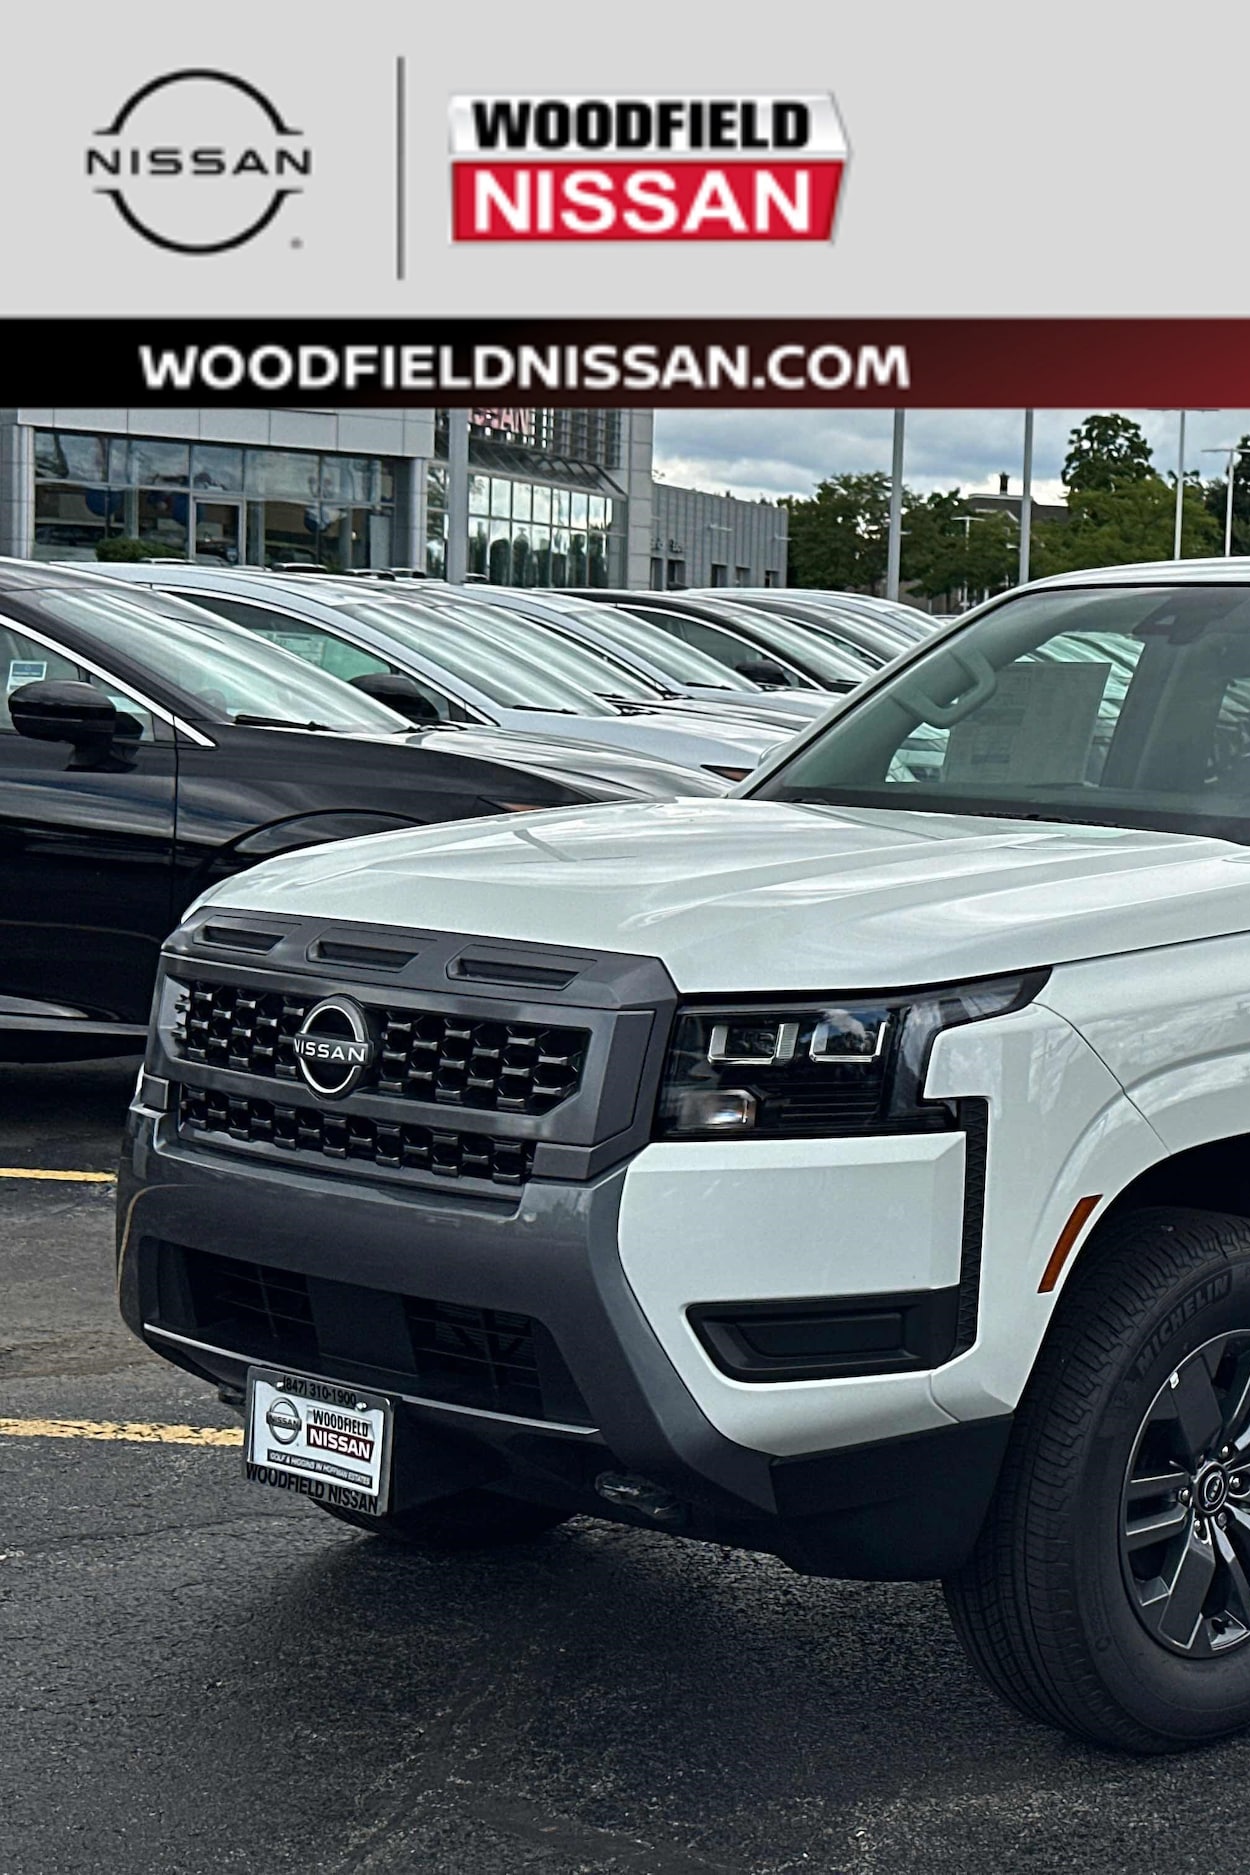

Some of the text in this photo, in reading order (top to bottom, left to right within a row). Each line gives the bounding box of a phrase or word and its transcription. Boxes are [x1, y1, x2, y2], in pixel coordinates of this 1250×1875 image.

[294, 1037, 365, 1062] NISSAN
[1137, 1274, 1229, 1375] MICHELIN
[283, 1376, 357, 1407] (847) 310-1900
[313, 1408, 369, 1438] WOODFIELD
[309, 1428, 370, 1460] NISSAN
[246, 1463, 378, 1515] WOODFIELD NISSAN
